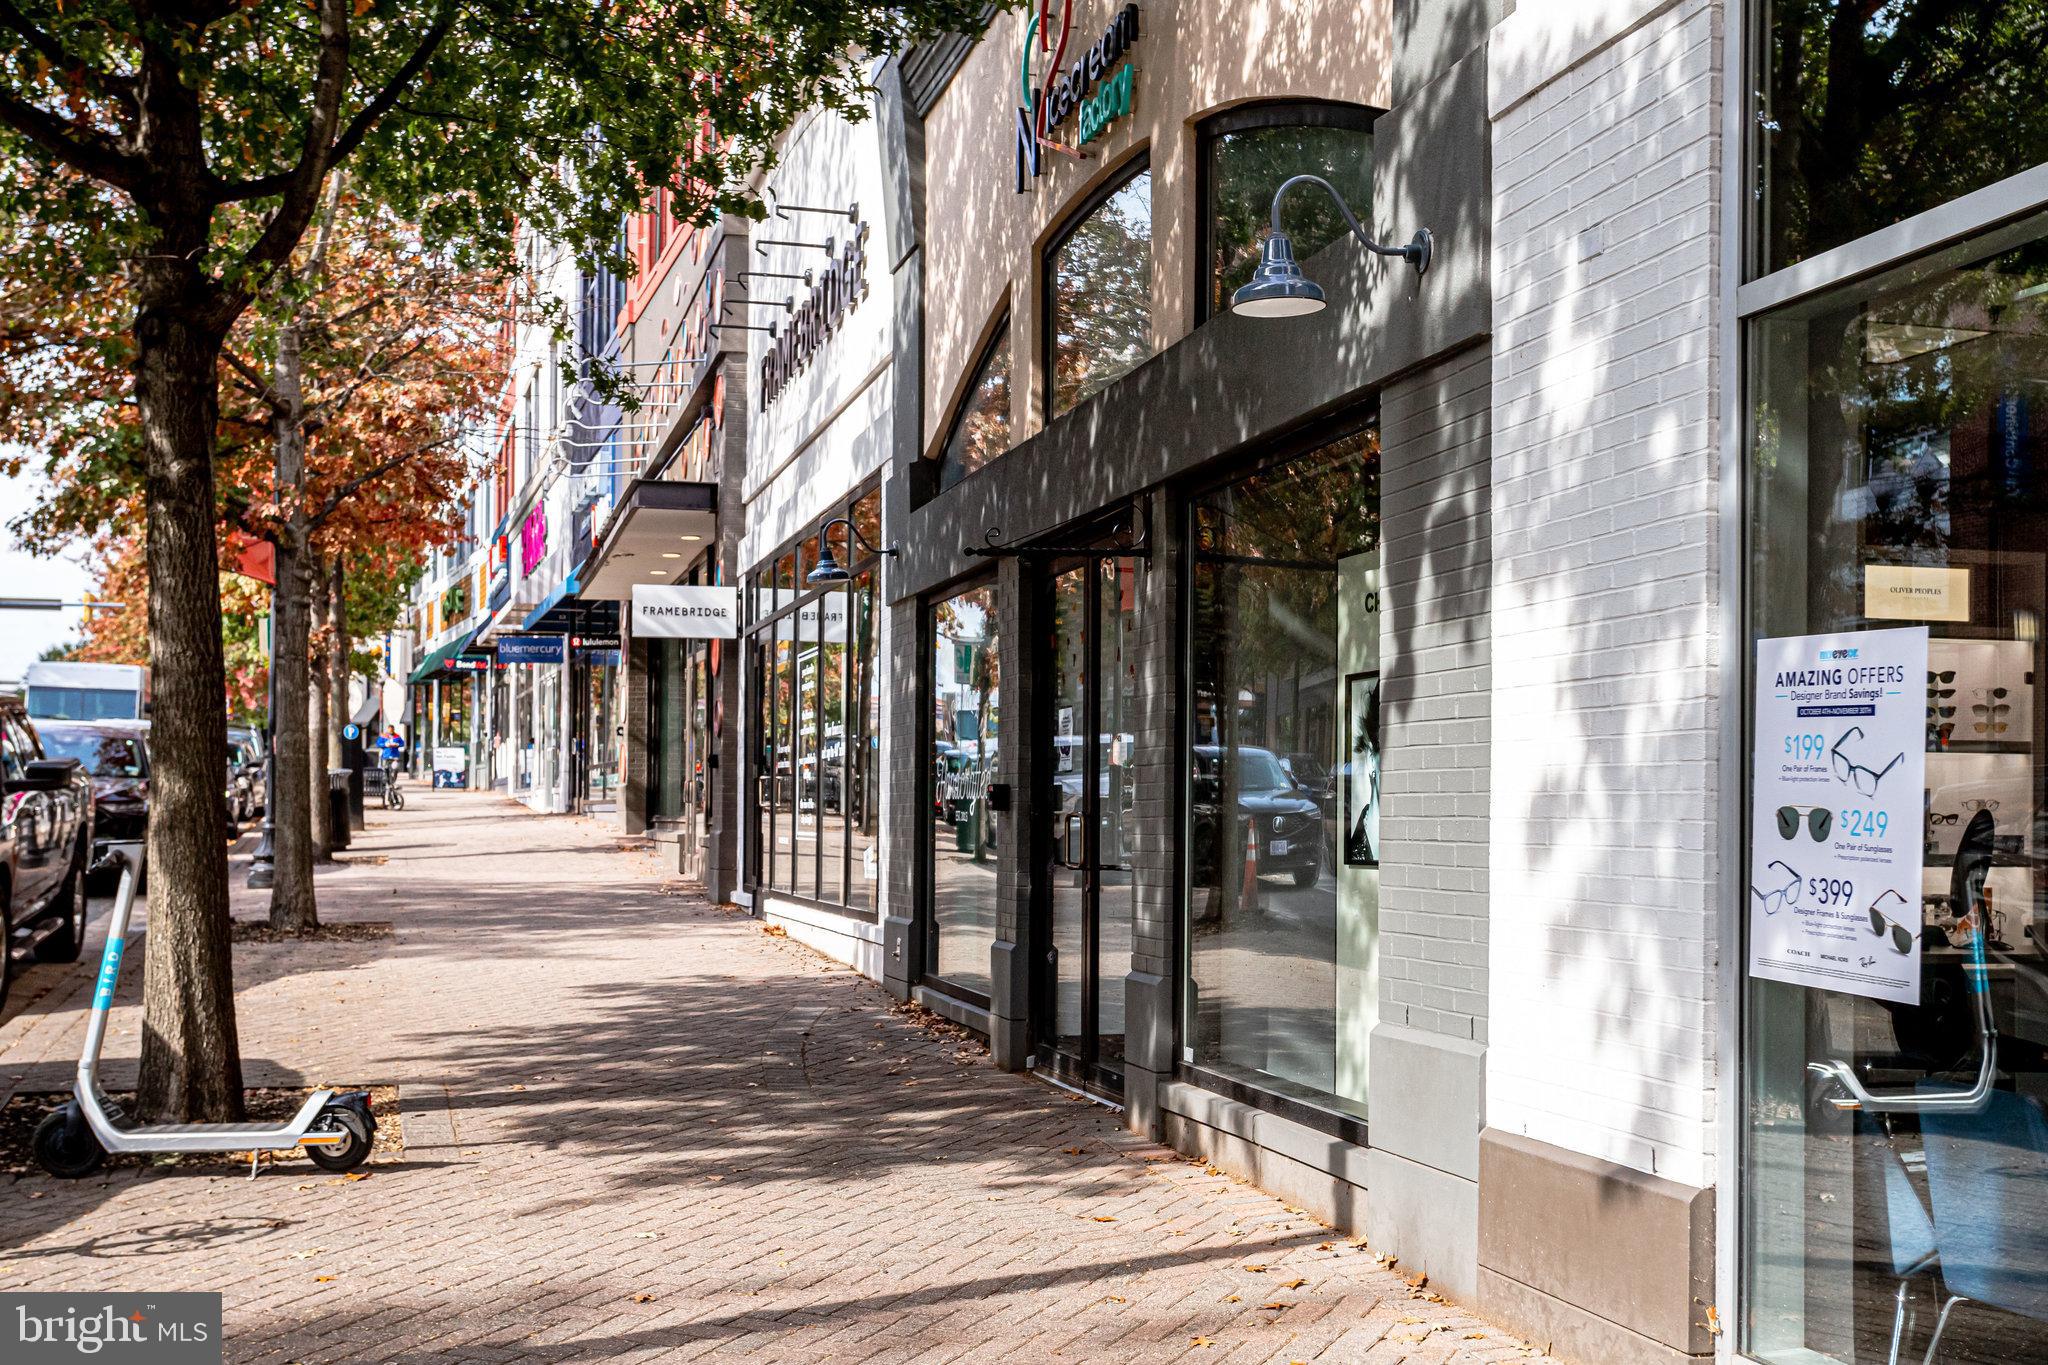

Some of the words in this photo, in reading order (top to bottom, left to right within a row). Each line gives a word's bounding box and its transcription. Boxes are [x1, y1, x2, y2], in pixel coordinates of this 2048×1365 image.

[761, 221, 866, 413] FRAMEBRIDGE
[1890, 586, 1913, 594] OLIVER
[1914, 587, 1941, 595] PEOPLES
[642, 606, 727, 618] FRAMEBRIDGE
[499, 643, 562, 656] bluemercury
[582, 638, 619, 646] lululemon
[1775, 668, 1842, 687] AMAZING
[1847, 665, 1904, 685] OFFERS
[1790, 689, 1823, 703] Designer
[1824, 688, 1847, 699] Brand
[1848, 687, 1883, 702] Savings!
[1799, 708, 1822, 716] OCTOBER
[1784, 734, 1825, 760] $199
[1782, 764, 1792, 772] One
[1793, 764, 1802, 772] Pair
[1803, 764, 1808, 772] of
[1809, 765, 1828, 773] Frames
[1840, 809, 1888, 838] $249
[1834, 841, 1846, 850] One
[1847, 842, 1857, 851] Pair
[1857, 843, 1863, 851] of
[1863, 843, 1893, 855] Sunglasses
[1809, 877, 1853, 907] $399
[1793, 906, 1816, 917] Designer
[1816, 908, 1835, 919] Frames
[1841, 912, 1869, 923] Sunglasses
[1786, 949, 1811, 957] COACH
[99, 951, 119, 997] BIRD
